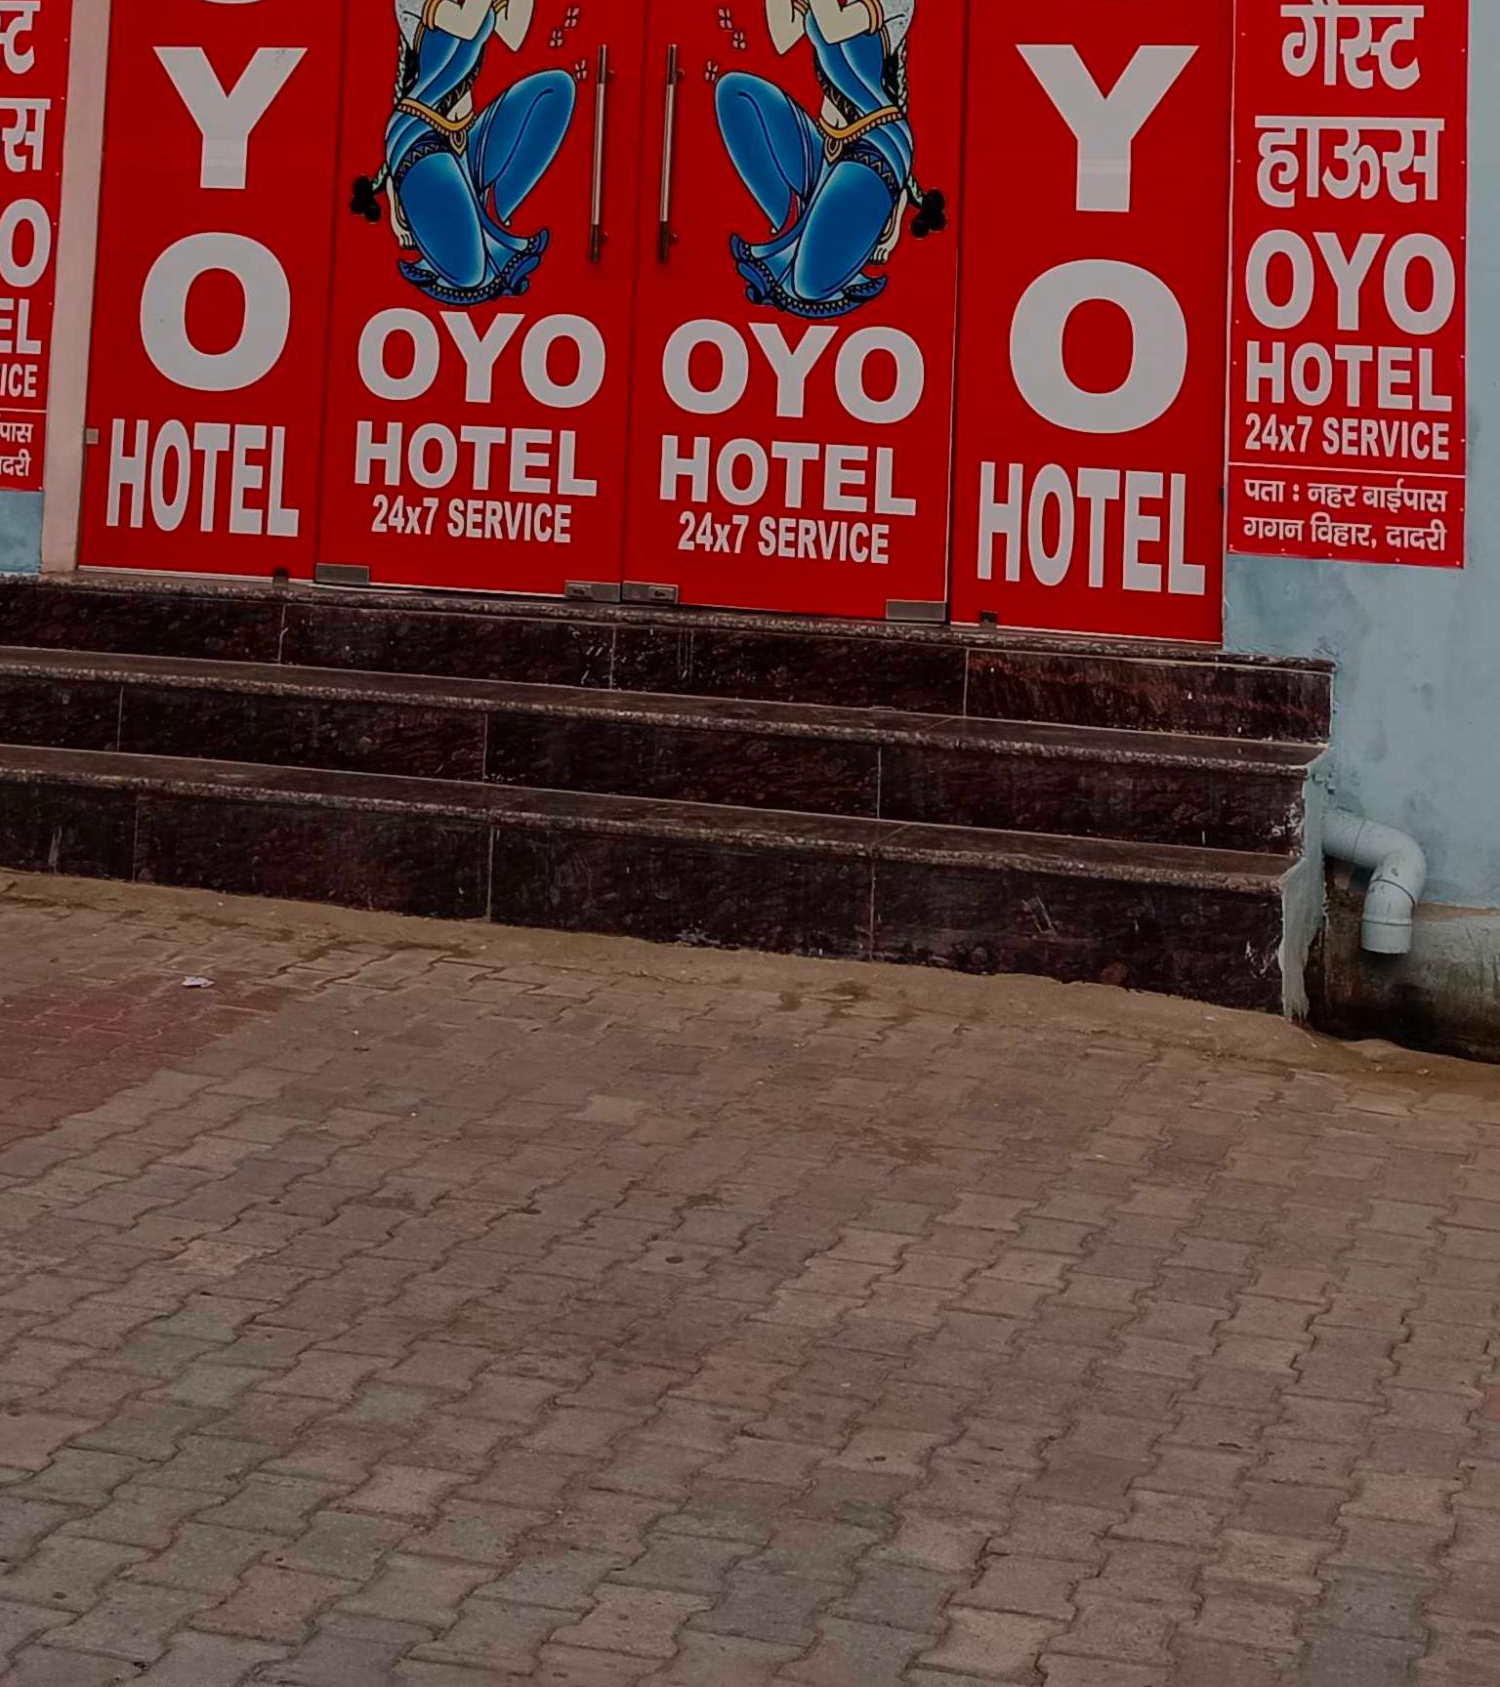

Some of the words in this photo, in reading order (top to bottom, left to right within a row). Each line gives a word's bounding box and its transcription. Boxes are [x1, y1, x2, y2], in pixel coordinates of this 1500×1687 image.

[1254, 115, 1445, 208] हाऊस
[1245, 229, 1455, 336] OYO
[357, 307, 606, 409] OYO
[661, 318, 925, 424] OYO
[1246, 341, 1452, 412] HOTEL
[354, 420, 598, 497] HOTEL
[658, 434, 917, 517] HOTEL
[1244, 412, 1313, 453] 24x7
[1322, 416, 1450, 461] SERVICE
[106, 418, 300, 538] HOTEL
[1244, 478, 1286, 503] पता
[1307, 482, 1358, 509] नहर
[1362, 478, 1448, 513] बाईपास
[371, 494, 440, 537] 24x7
[447, 498, 572, 544] SERVICE
[677, 510, 750, 554] 24x7
[757, 515, 890, 565] SERVICE
[976, 460, 1206, 596] HOTEL
[1243, 516, 1305, 541] गगन
[1310, 511, 1377, 549] विहार,
[1385, 518, 1447, 551] दादरी
